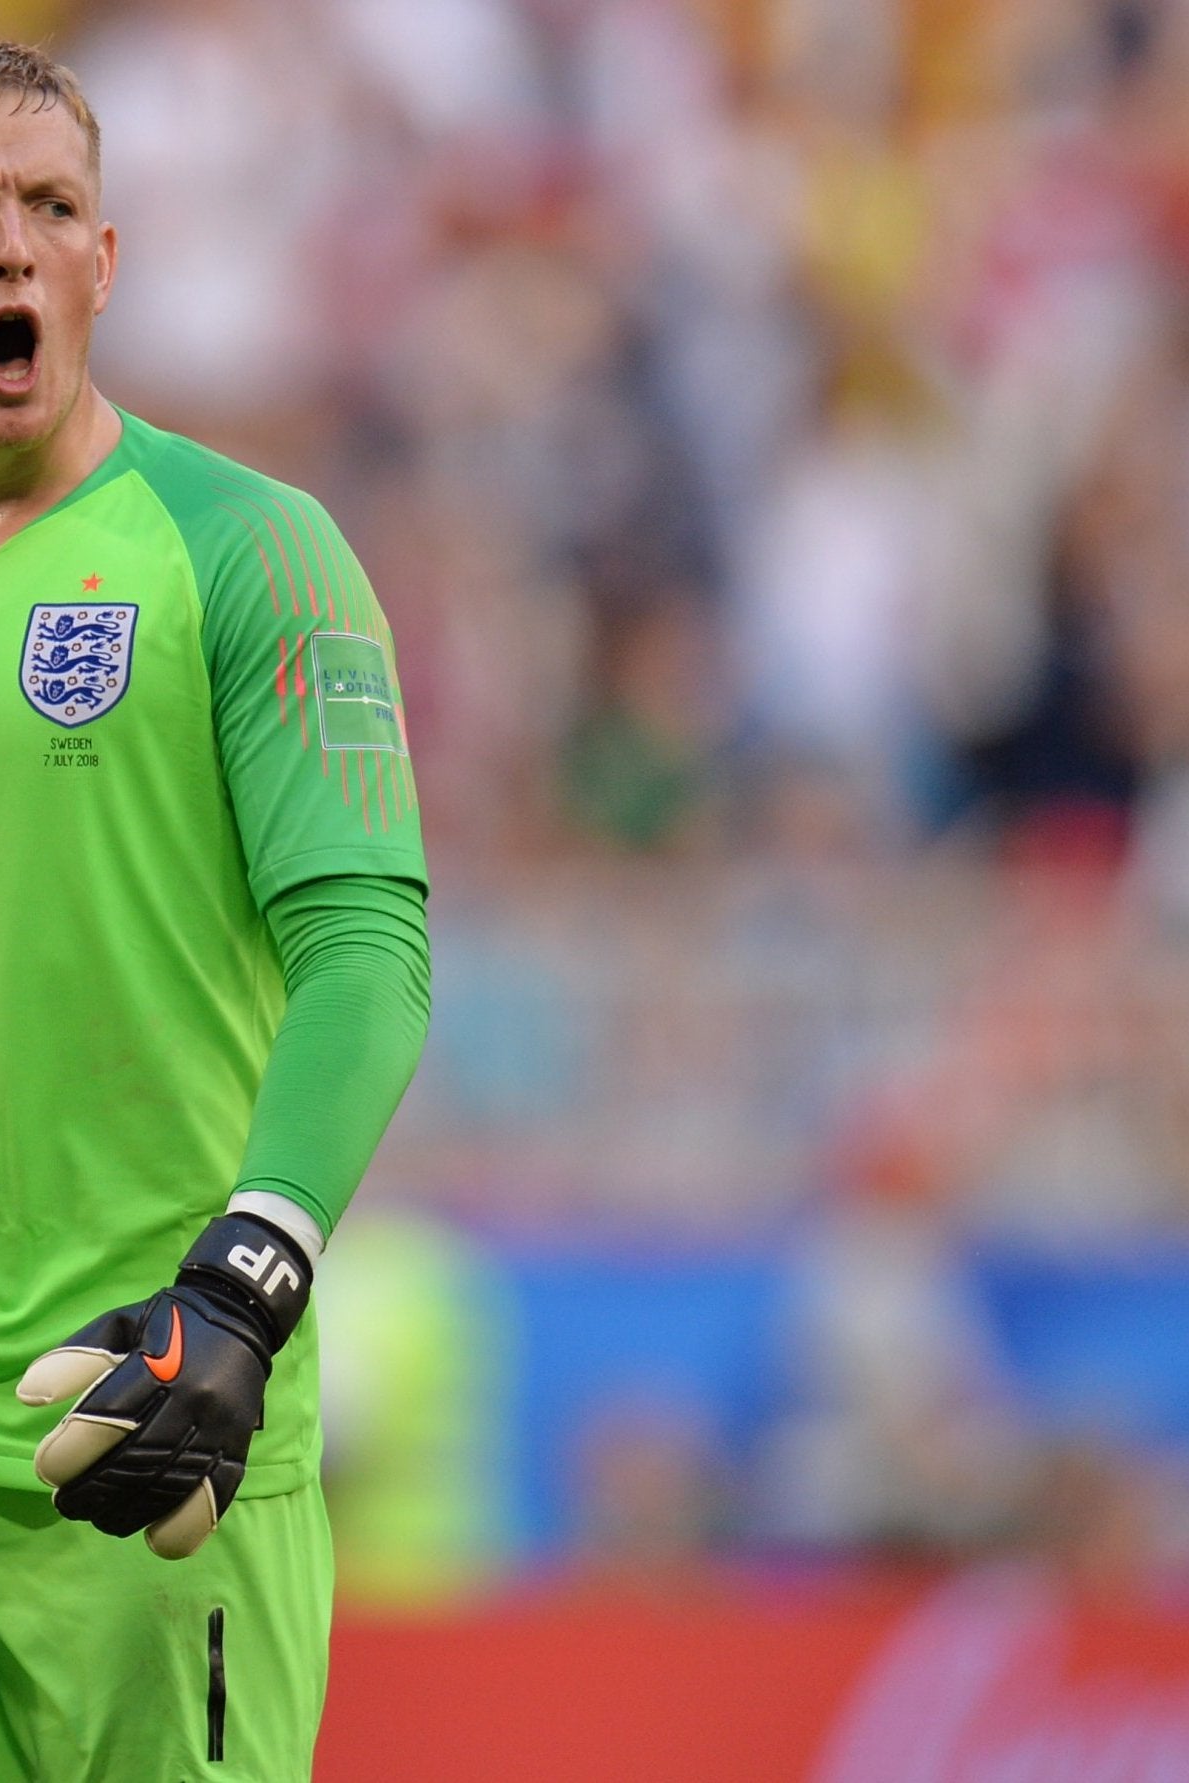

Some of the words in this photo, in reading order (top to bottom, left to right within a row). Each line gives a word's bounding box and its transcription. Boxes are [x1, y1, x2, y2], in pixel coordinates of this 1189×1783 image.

[50, 737, 92, 750] SWEDEN
[43, 754, 50, 767] 7
[53, 754, 74, 767] JULY
[76, 754, 99, 767] 2018
[227, 1244, 299, 1296] JP
